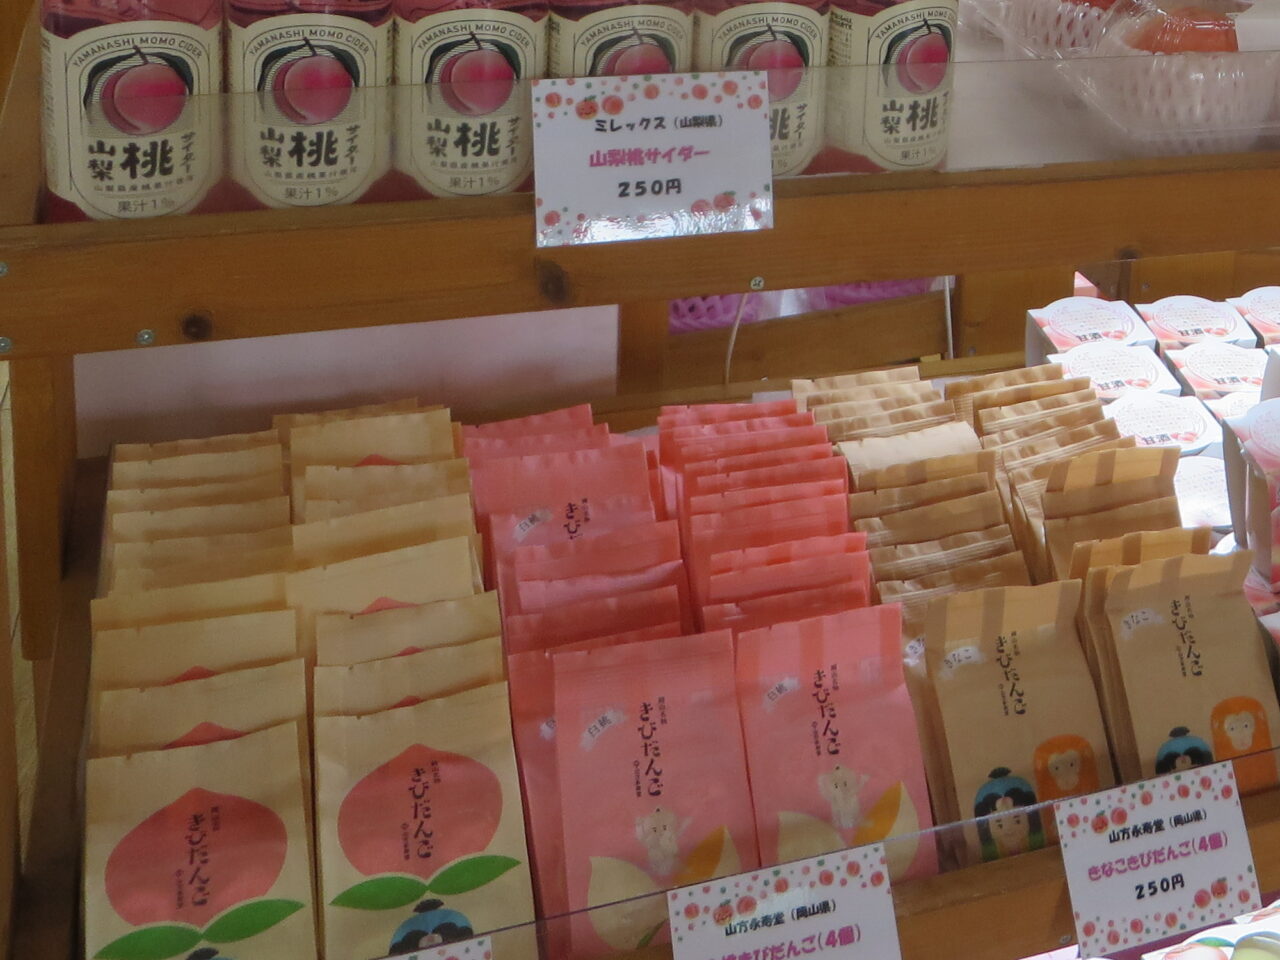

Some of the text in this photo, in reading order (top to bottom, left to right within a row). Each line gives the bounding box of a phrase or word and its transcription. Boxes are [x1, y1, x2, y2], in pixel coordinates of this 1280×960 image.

[139, 36, 176, 47] MOMO
[309, 28, 344, 39] MOMO
[475, 24, 507, 34] MOMO
[906, 97, 939, 132] 桃
[288, 129, 339, 168] 桃
[453, 120, 500, 158] 桃
[588, 144, 711, 168] 山梨桃サイダー
[120, 139, 174, 180] 桃
[618, 177, 683, 198] 250円
[812, 669, 841, 756] きびだんご
[637, 702, 664, 797] きびだんご
[408, 767, 434, 859] きびだんご
[184, 813, 209, 907] きびだんご
[1134, 873, 1186, 900] 250円
